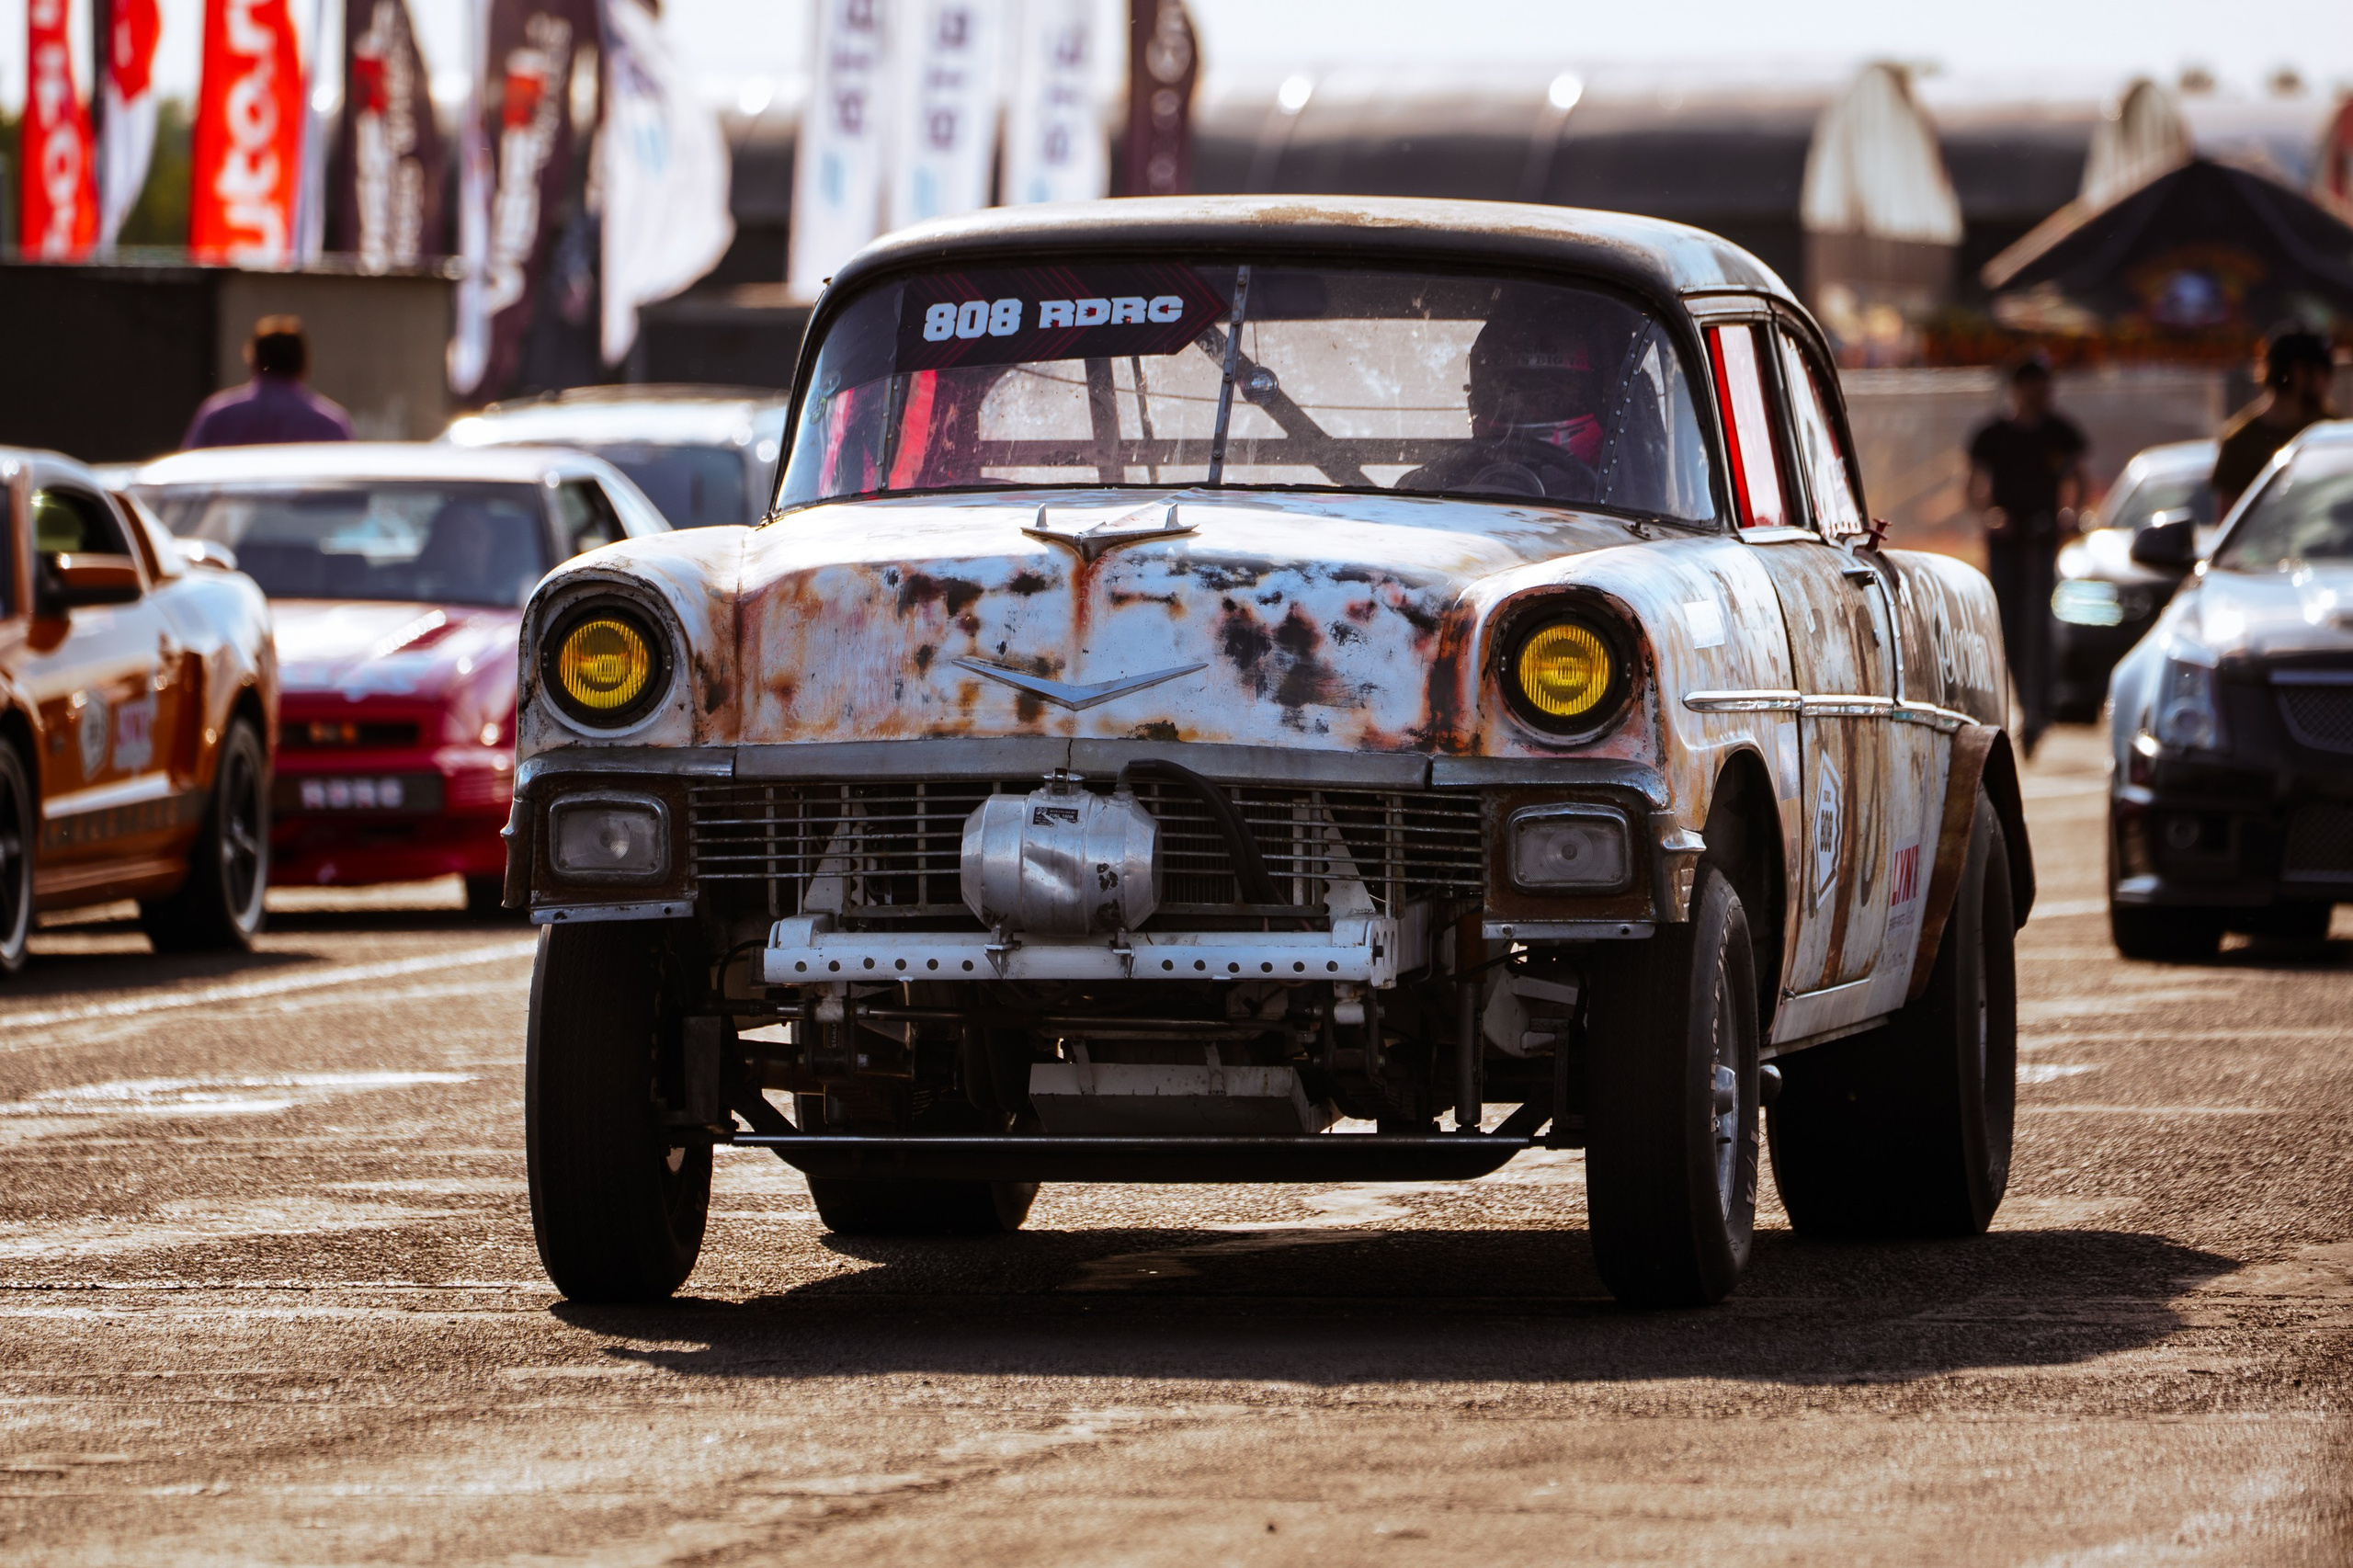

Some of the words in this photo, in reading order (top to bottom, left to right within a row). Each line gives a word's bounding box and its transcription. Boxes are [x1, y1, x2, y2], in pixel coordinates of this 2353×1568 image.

[922, 298, 1023, 342] 808
[1039, 295, 1184, 329] RDRC
[1820, 809, 1834, 852] 808
